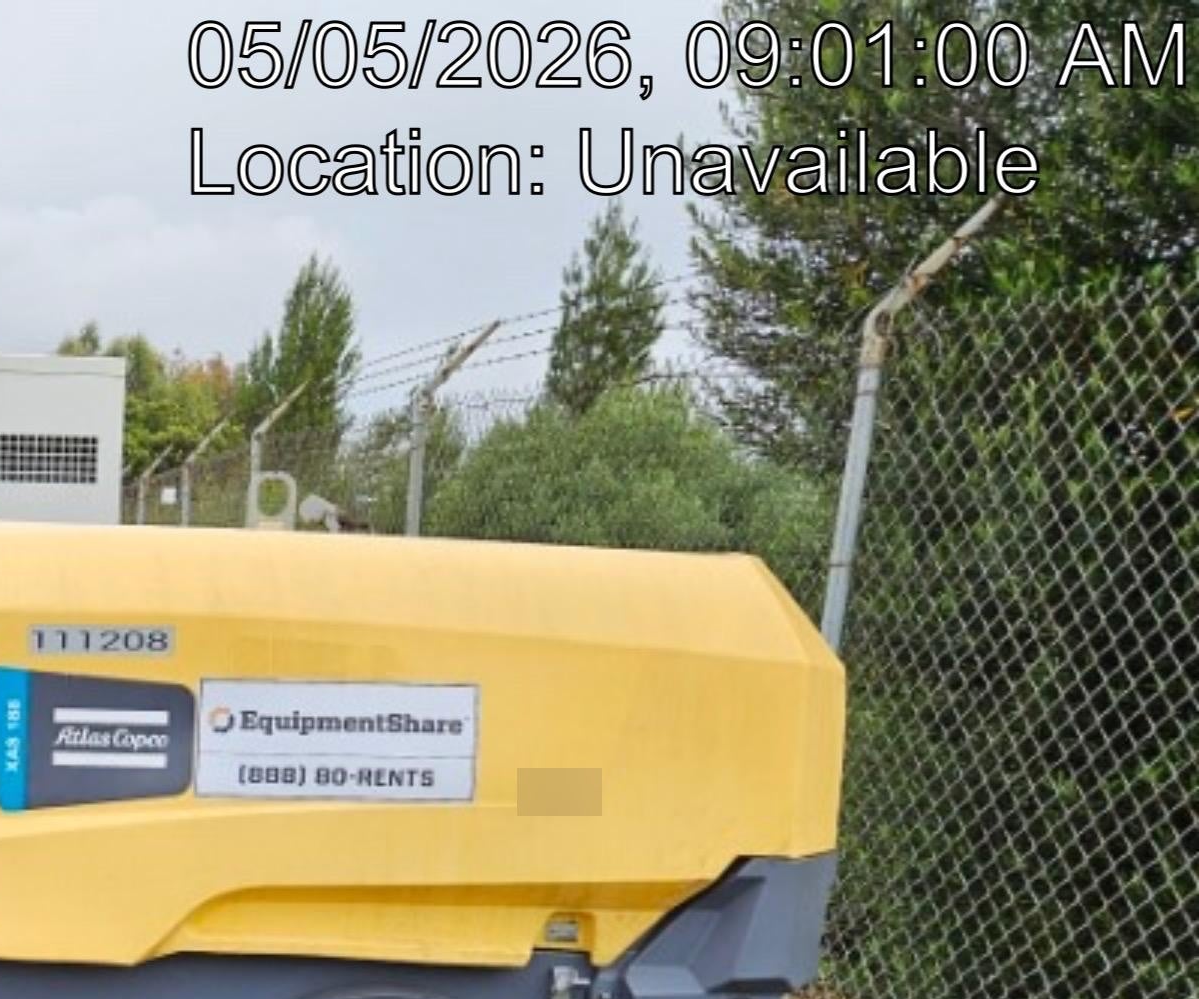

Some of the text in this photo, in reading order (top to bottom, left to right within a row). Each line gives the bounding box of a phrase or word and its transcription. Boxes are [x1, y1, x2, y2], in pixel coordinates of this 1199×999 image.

[33, 629, 169, 651] 111208
[240, 710, 463, 735] EquipmentShare
[55, 726, 169, 751] Atlas Copco
[5, 737, 21, 773] XAS
[238, 764, 435, 787] (888) 80-RENTS
